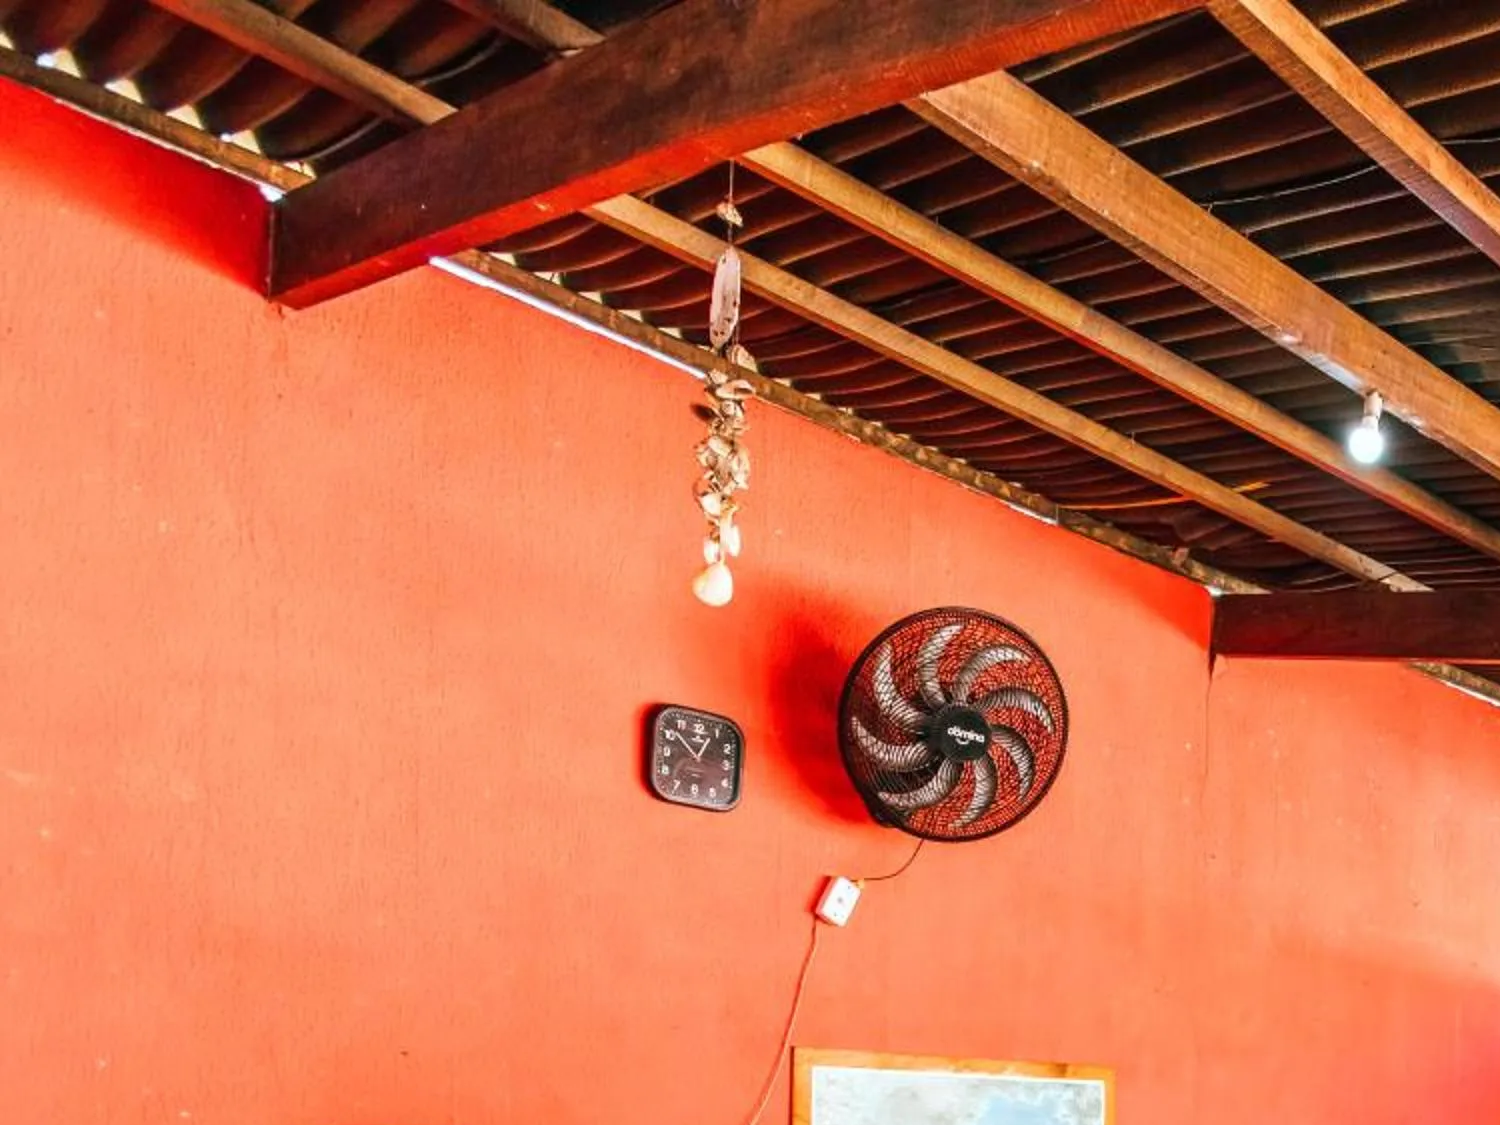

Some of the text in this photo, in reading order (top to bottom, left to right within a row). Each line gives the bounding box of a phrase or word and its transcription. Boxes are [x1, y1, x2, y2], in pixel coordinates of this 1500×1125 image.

[693, 723, 705, 734] 12
[724, 743, 731, 755] 2
[722, 760, 730, 771] 3
[672, 780, 681, 794] 7
